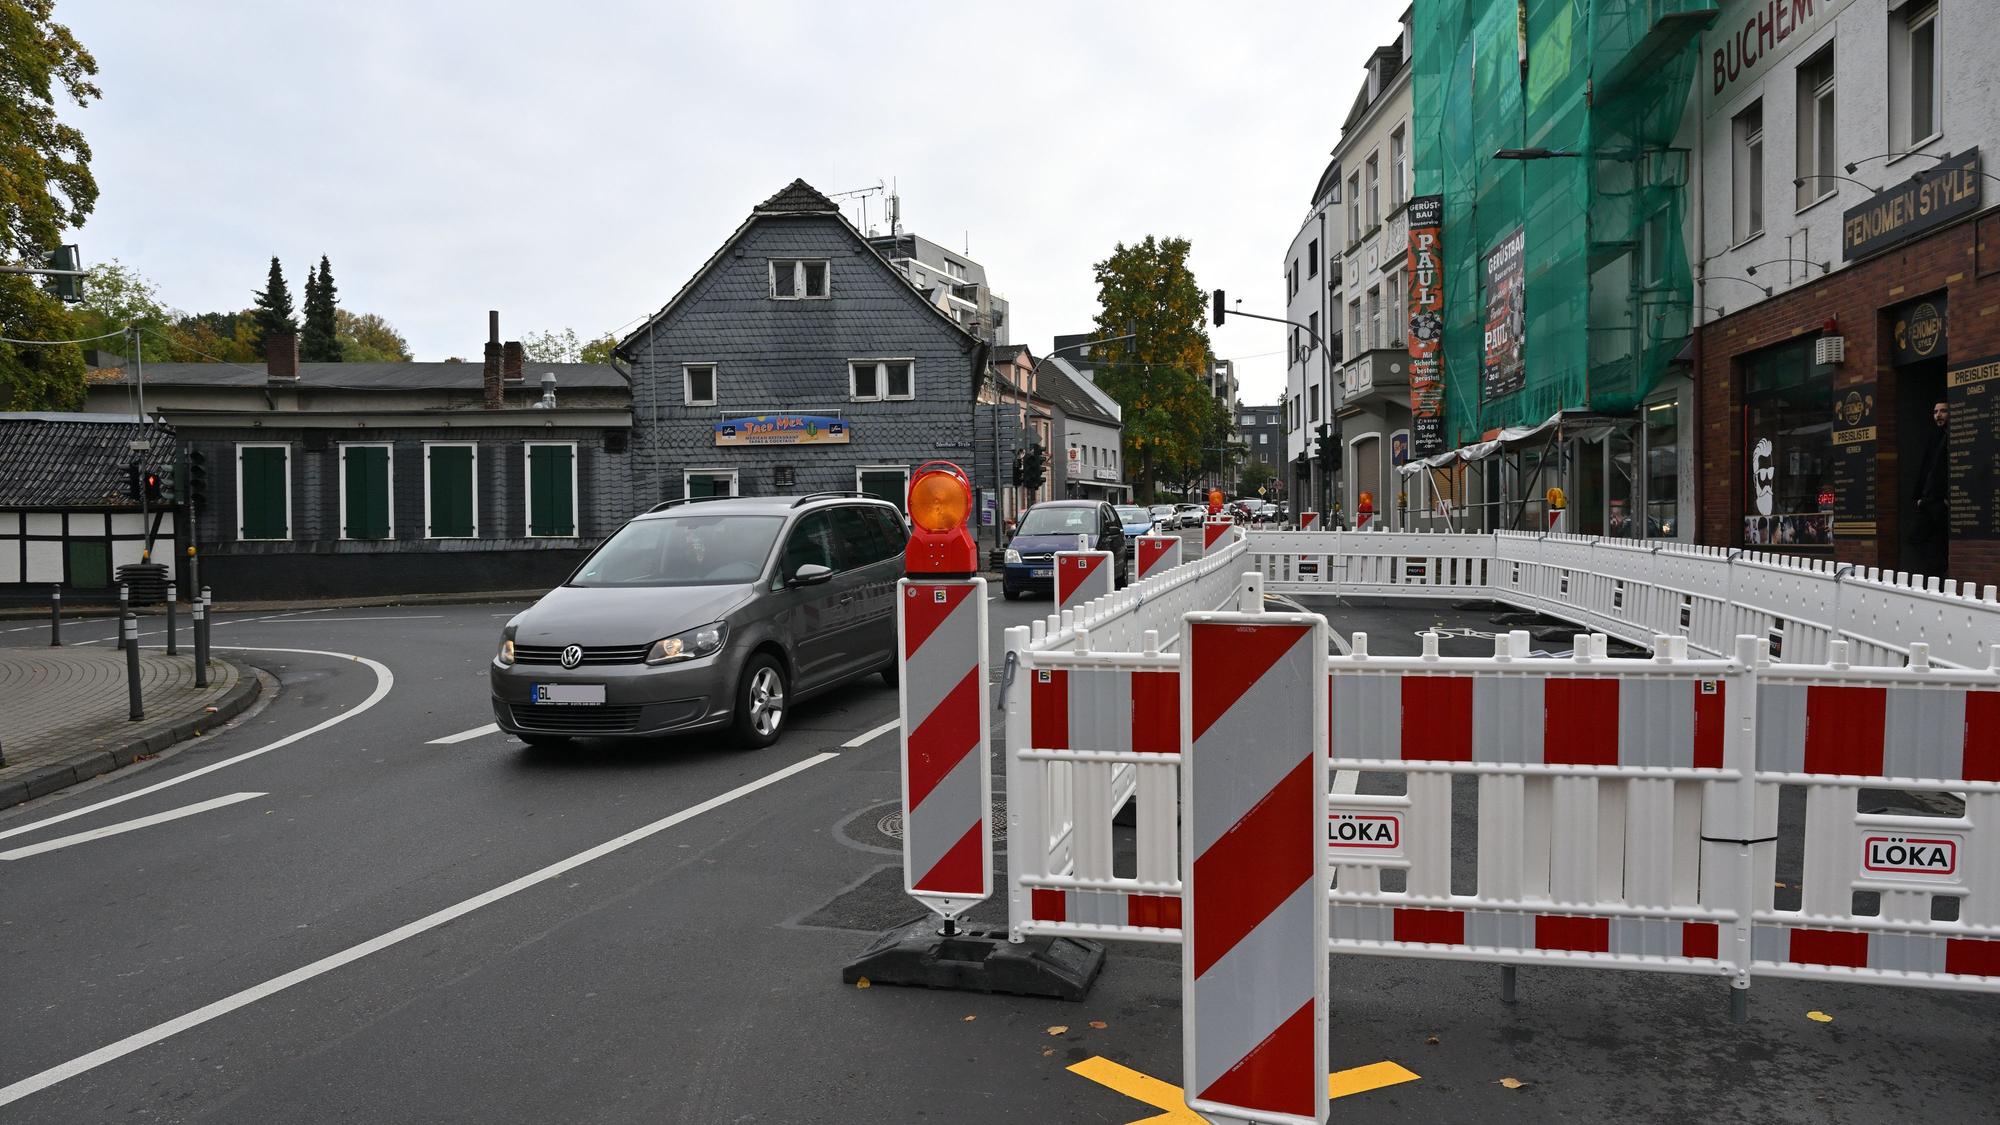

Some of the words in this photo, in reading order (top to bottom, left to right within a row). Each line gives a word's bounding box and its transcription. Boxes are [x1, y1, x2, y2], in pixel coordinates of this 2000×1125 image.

[1409, 201, 1441, 212] GERÜST-
[1416, 211, 1433, 219] BAU
[1845, 190, 1915, 249] FENOMEN
[1920, 162, 1976, 216] STYLE
[1488, 231, 1525, 274] GERÜSTBAU
[1416, 234, 1435, 304] PAUL
[1485, 323, 1508, 352] PAUL
[1954, 364, 1999, 384] PREISLISTE
[1838, 428, 1870, 442] PREISLISTE
[538, 687, 551, 700] GL
[1329, 815, 1393, 842] LÖKA
[1872, 837, 1948, 867] LÖKA
